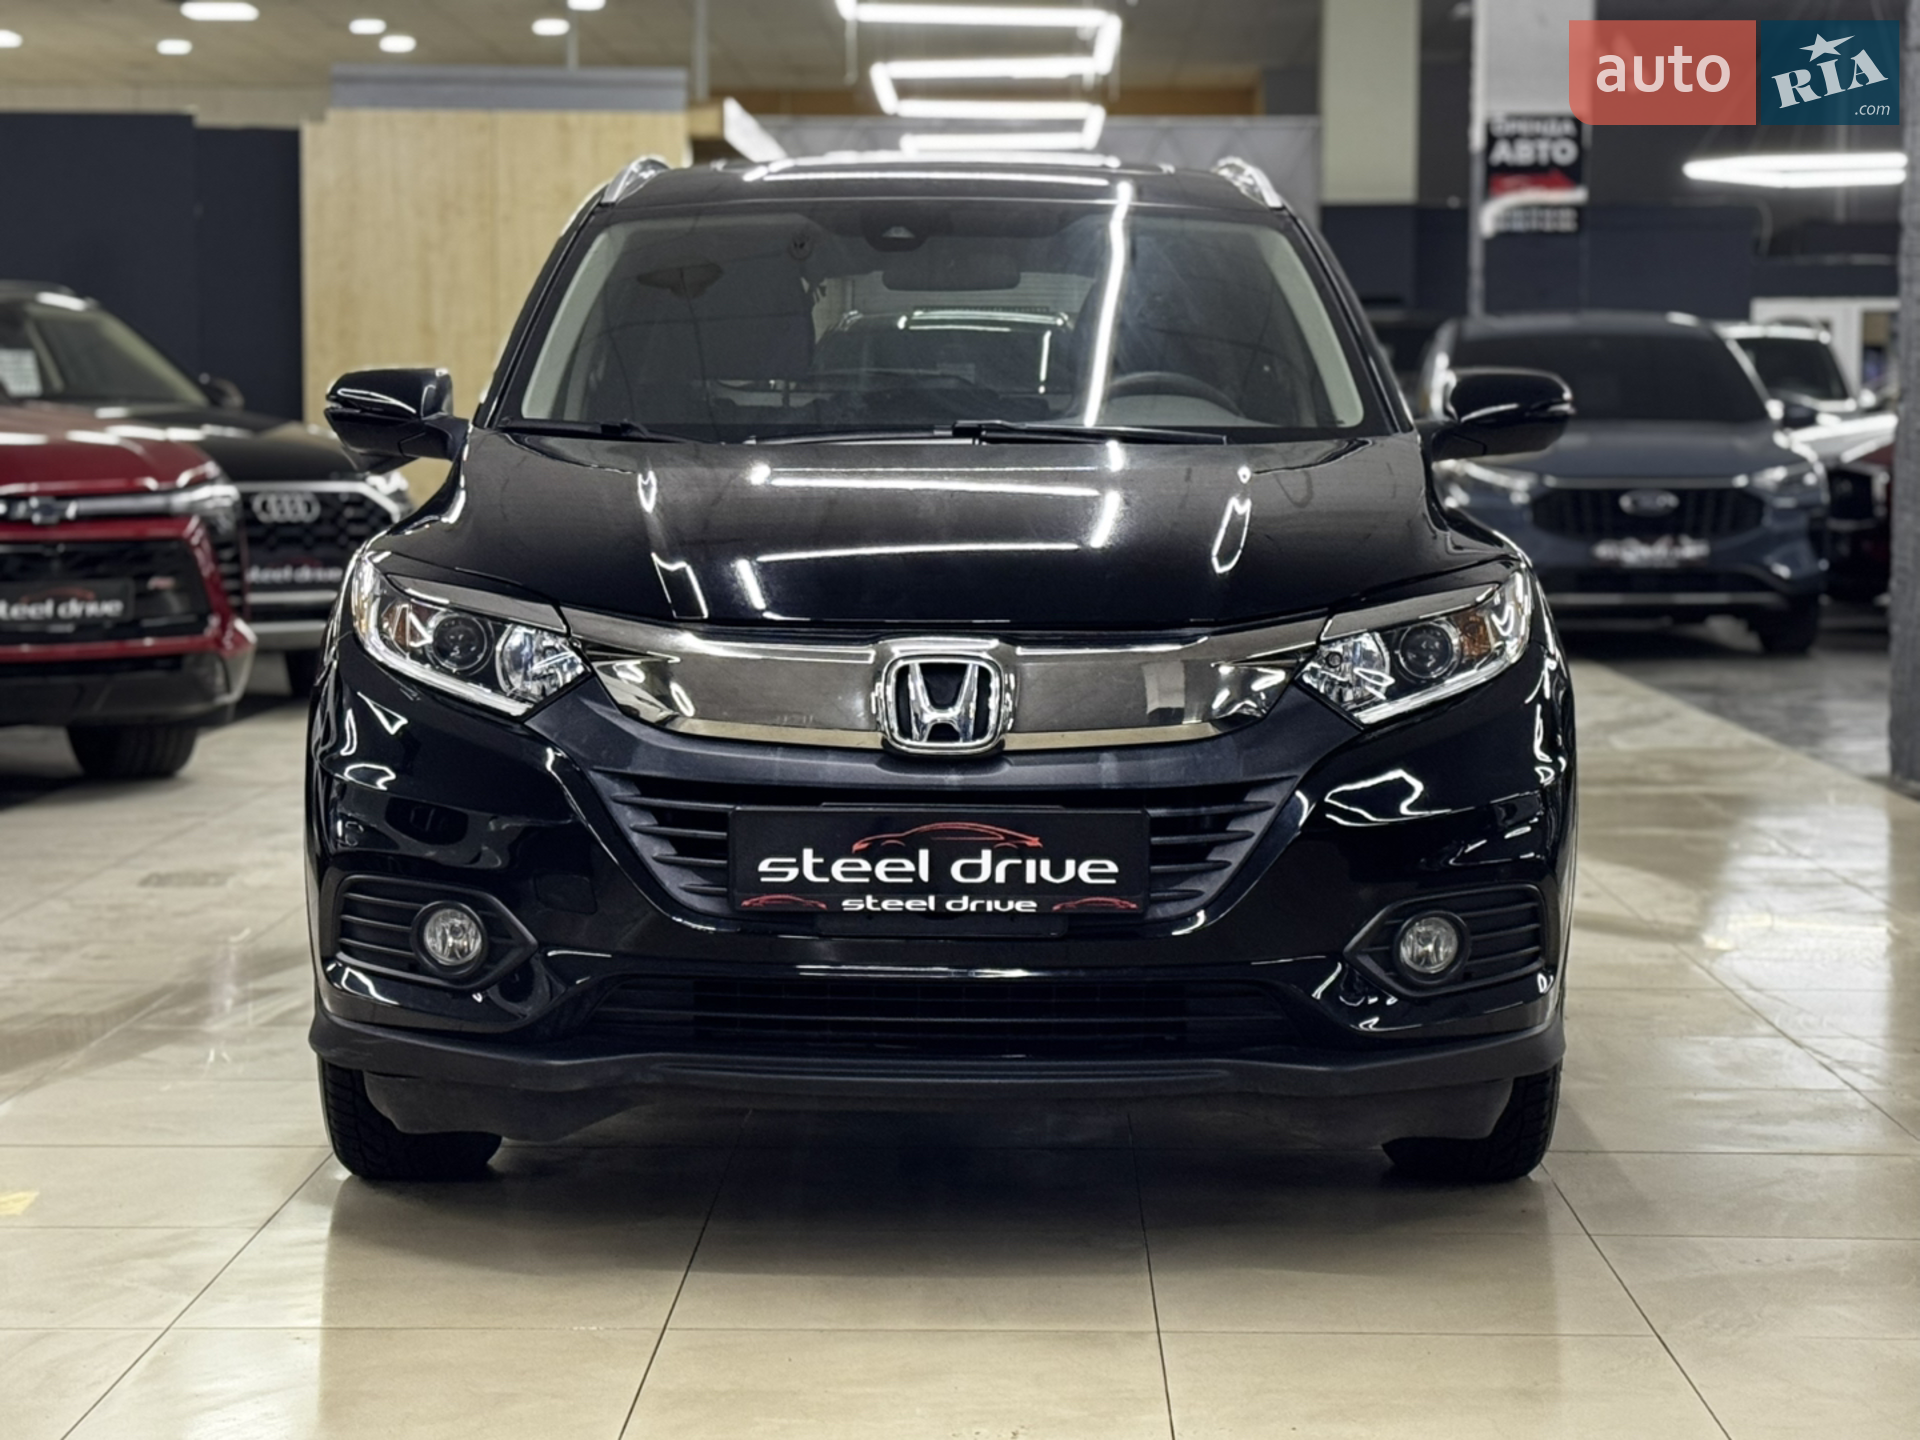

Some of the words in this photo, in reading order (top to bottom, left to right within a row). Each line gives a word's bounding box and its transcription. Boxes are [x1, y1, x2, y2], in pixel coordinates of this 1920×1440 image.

[1488, 138, 1578, 167] АВТО
[57, 598, 124, 618] drive
[758, 848, 930, 883] steel
[950, 849, 1120, 884] drive
[841, 894, 936, 912] steel
[945, 895, 1038, 912] drive
